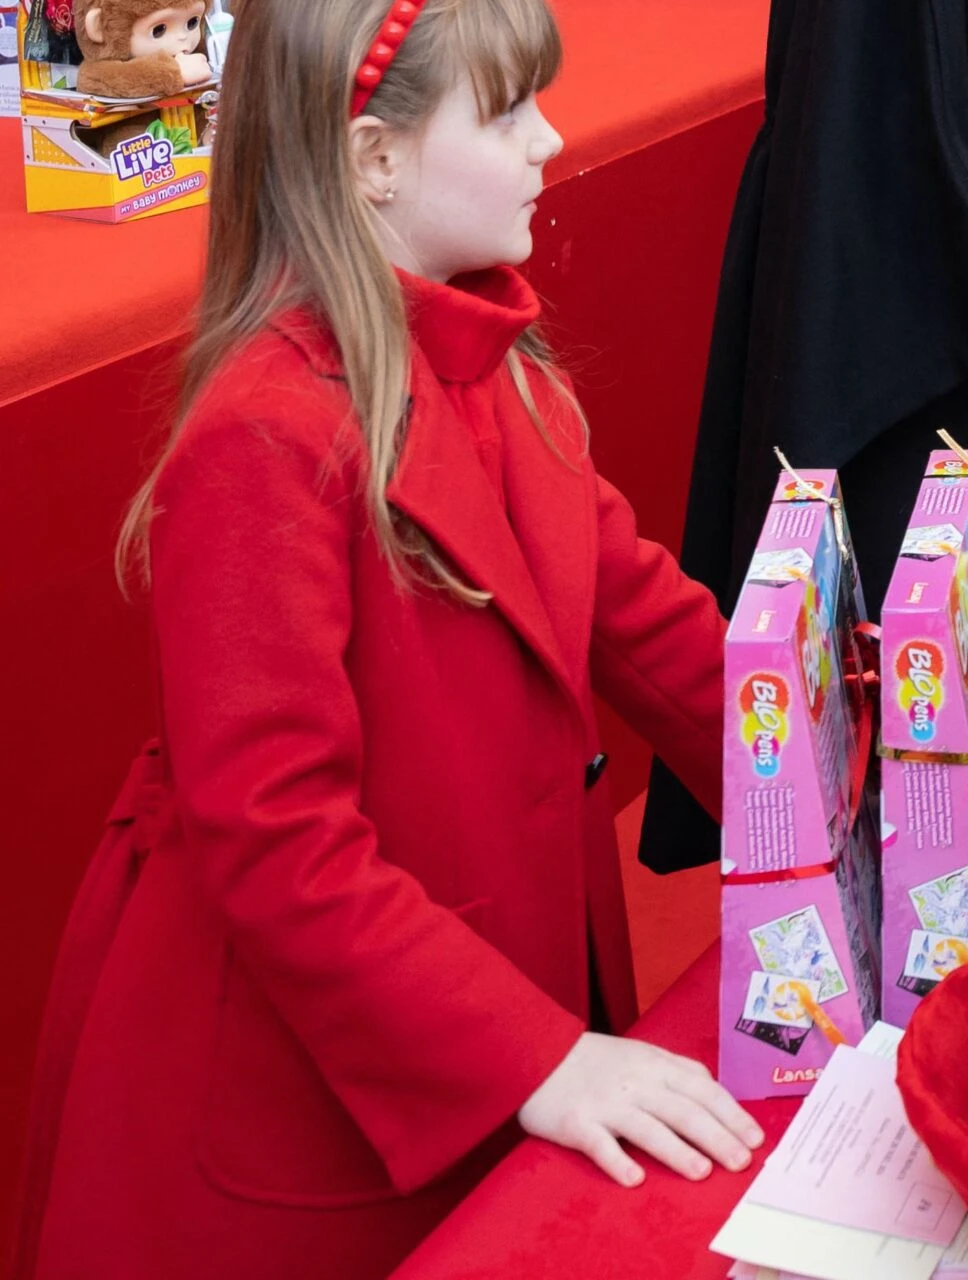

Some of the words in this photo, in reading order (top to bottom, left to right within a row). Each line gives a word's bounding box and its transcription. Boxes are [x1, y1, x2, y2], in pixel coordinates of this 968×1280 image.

[115, 143, 170, 180] Live
[121, 138, 151, 157] Little
[144, 164, 174, 187] Pets
[911, 696, 930, 731] pens
[755, 730, 773, 767] pens
